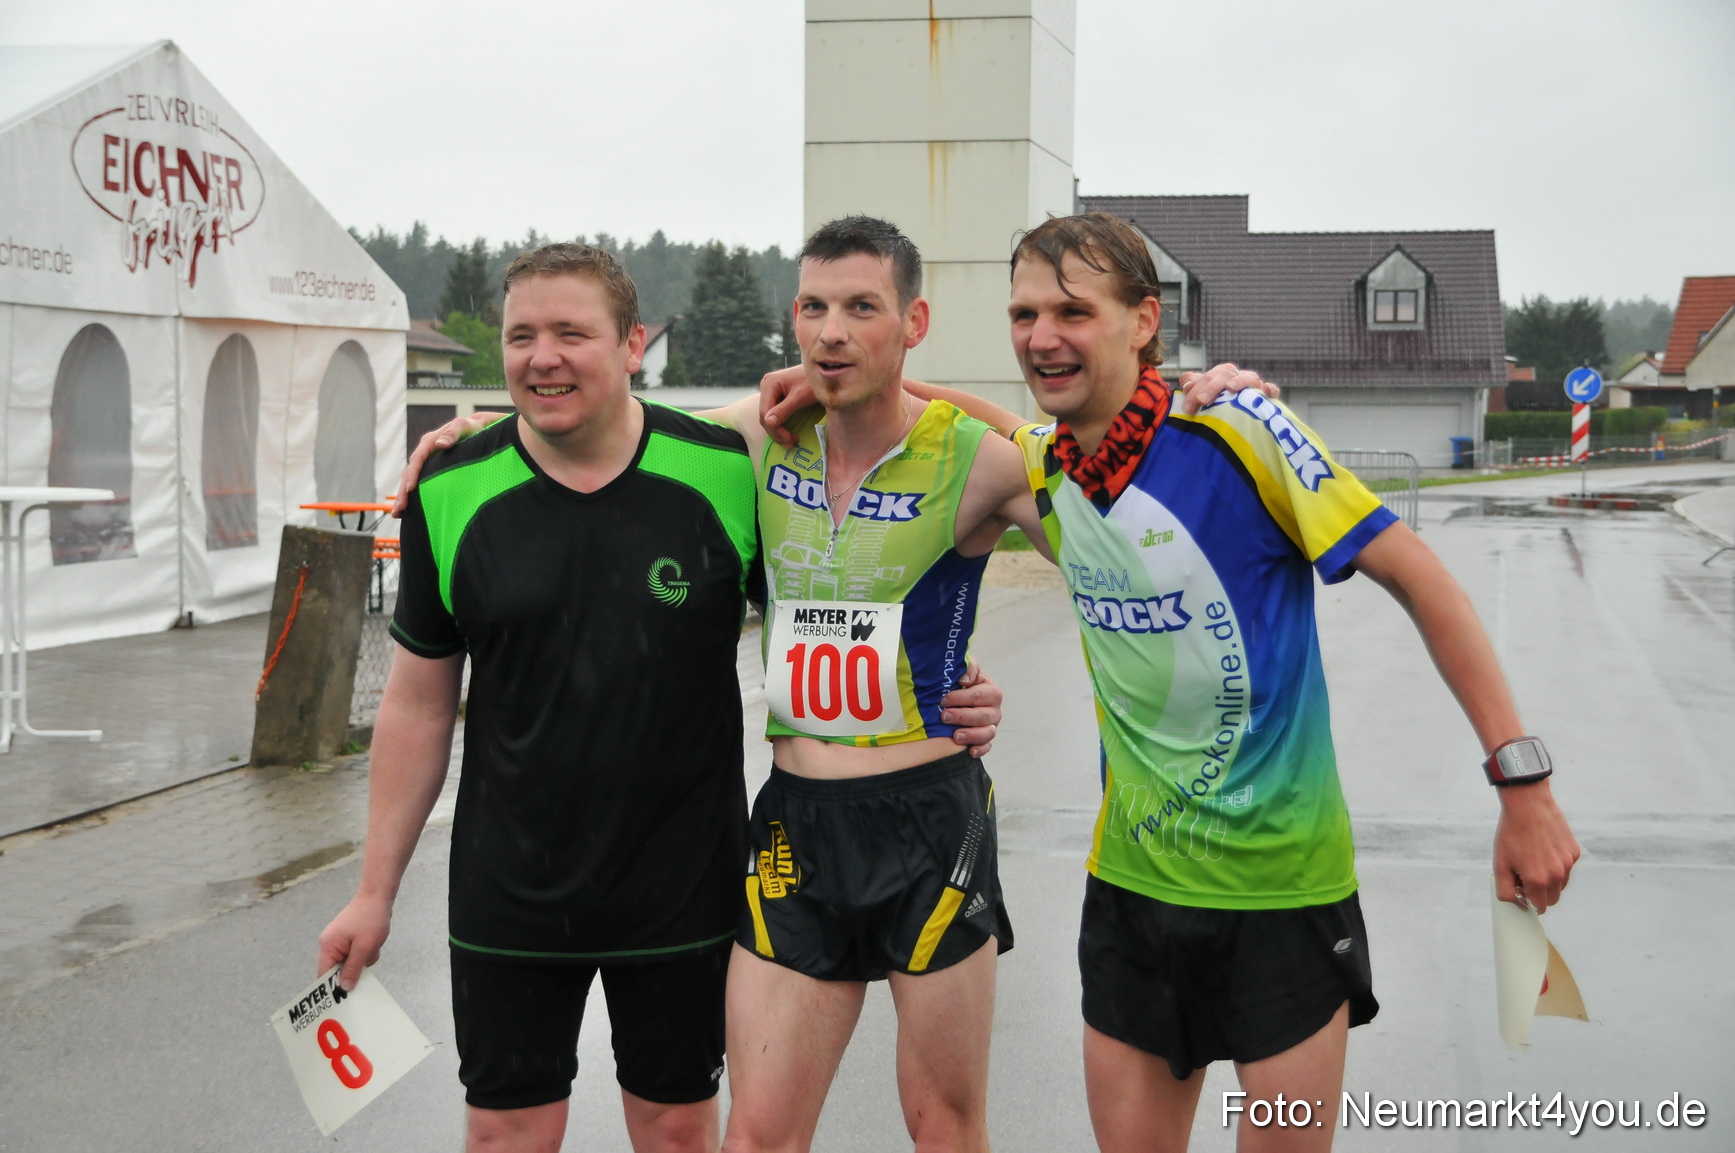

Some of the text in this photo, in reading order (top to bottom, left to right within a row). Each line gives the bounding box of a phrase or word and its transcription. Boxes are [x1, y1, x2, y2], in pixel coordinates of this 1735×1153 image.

[103, 133, 245, 212] EICHNER
[766, 463, 927, 522] BOCK
[1068, 562, 1132, 593] TEAM
[793, 608, 847, 625] MEYER
[793, 624, 847, 637] WERBUNG
[1073, 589, 1193, 634] BOCK
[786, 643, 884, 722] 100
[964, 901, 988, 918] adidas
[288, 982, 329, 1025] MEYER
[292, 997, 333, 1034] WERBUNG
[317, 1018, 374, 1090] 8
